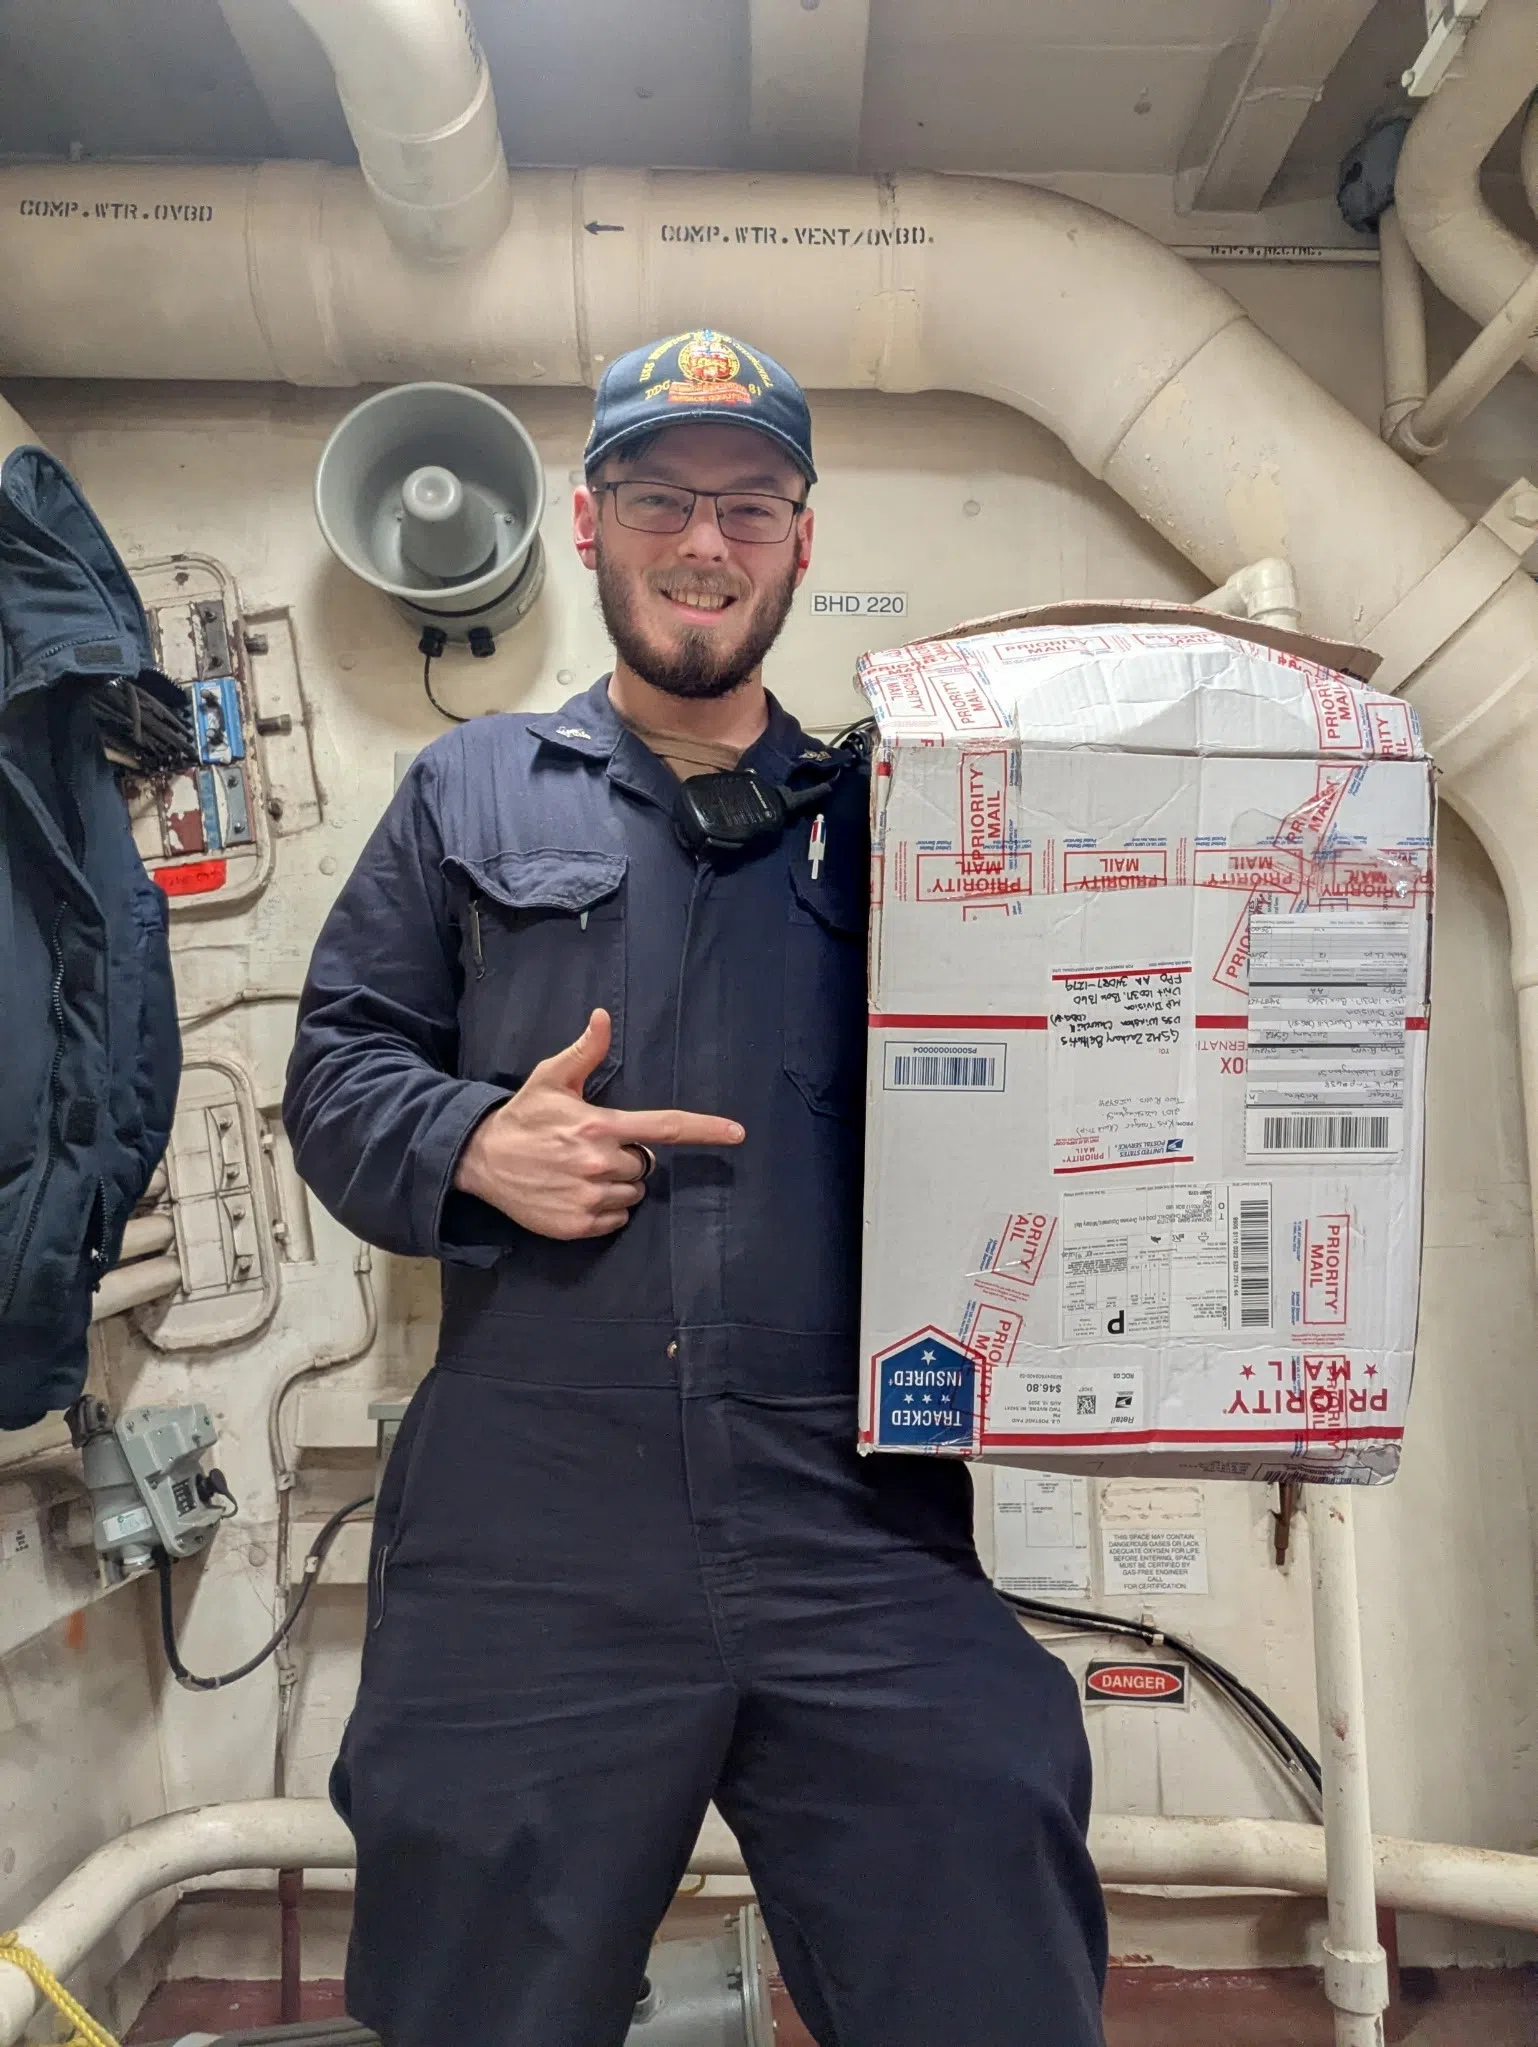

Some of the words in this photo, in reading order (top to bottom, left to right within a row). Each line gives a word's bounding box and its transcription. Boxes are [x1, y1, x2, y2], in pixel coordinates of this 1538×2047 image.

[644, 381, 671, 401] DDG
[748, 383, 762, 396] 81
[814, 595, 860, 612] BHD
[867, 597, 904, 613] 220
[943, 680, 975, 724] PRIORITY
[962, 688, 986, 712] MAIL
[970, 768, 984, 860] PRIORITY
[987, 791, 1000, 839] MAIL
[955, 861, 1001, 875] MAIL
[1100, 858, 1139, 872] MAIL
[1229, 856, 1273, 869] MAIL
[1078, 874, 1158, 891] PRIORITY
[1208, 872, 1292, 885] PRIORITY
[1135, 975, 1150, 985] AA
[1160, 973, 1181, 983] FPO
[1101, 993, 1120, 1002] Box
[1157, 987, 1181, 996] Unit
[1124, 1001, 1161, 1011] Division
[1166, 999, 1180, 1009] MP
[1070, 1021, 1112, 1032] Churchill
[1120, 1017, 1158, 1026] Winston
[1161, 1016, 1180, 1024] USS
[1106, 1032, 1142, 1044] Zachary
[1146, 1028, 1179, 1043] GSM2
[1118, 1142, 1142, 1150] SERVICE
[1066, 1152, 1104, 1162] PRIORITY
[1119, 1149, 1140, 1158] STATES
[1310, 1245, 1323, 1288] MAIL
[1325, 1225, 1340, 1309] PRIORITY
[1107, 1310, 1124, 1334] P
[1268, 1361, 1351, 1381] MAIL
[1026, 1383, 1061, 1393] $46.80
[1228, 1389, 1388, 1414] PRIORITY
[892, 1410, 962, 1426] TRACKED
[1110, 1416, 1134, 1424] Retail
[1102, 1675, 1165, 1689] DANGER
